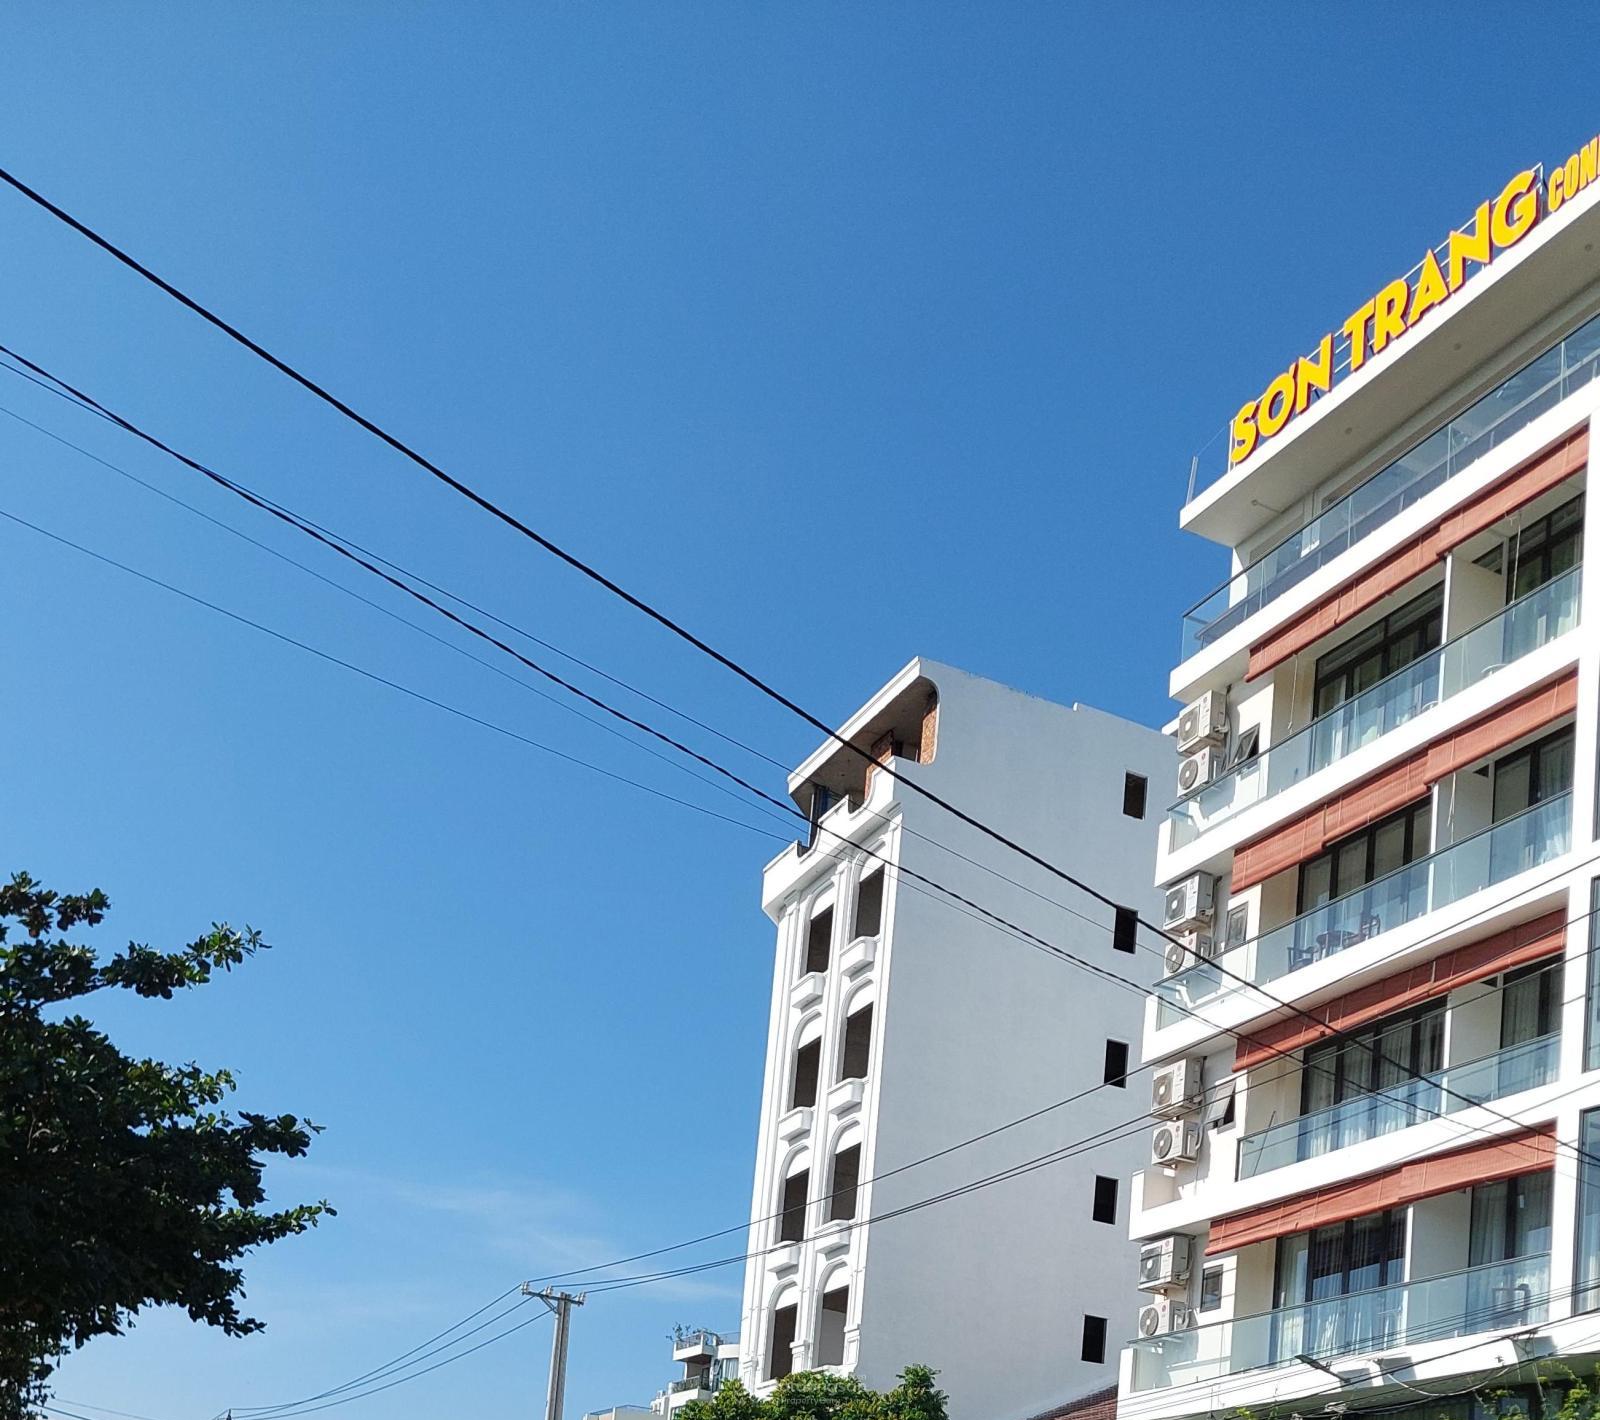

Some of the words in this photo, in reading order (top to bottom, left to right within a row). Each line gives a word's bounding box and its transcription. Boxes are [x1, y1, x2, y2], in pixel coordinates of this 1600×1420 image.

[1231, 332, 1336, 464] SƠN
[1343, 168, 1541, 371] TRANG
[1547, 136, 1600, 213] CON
